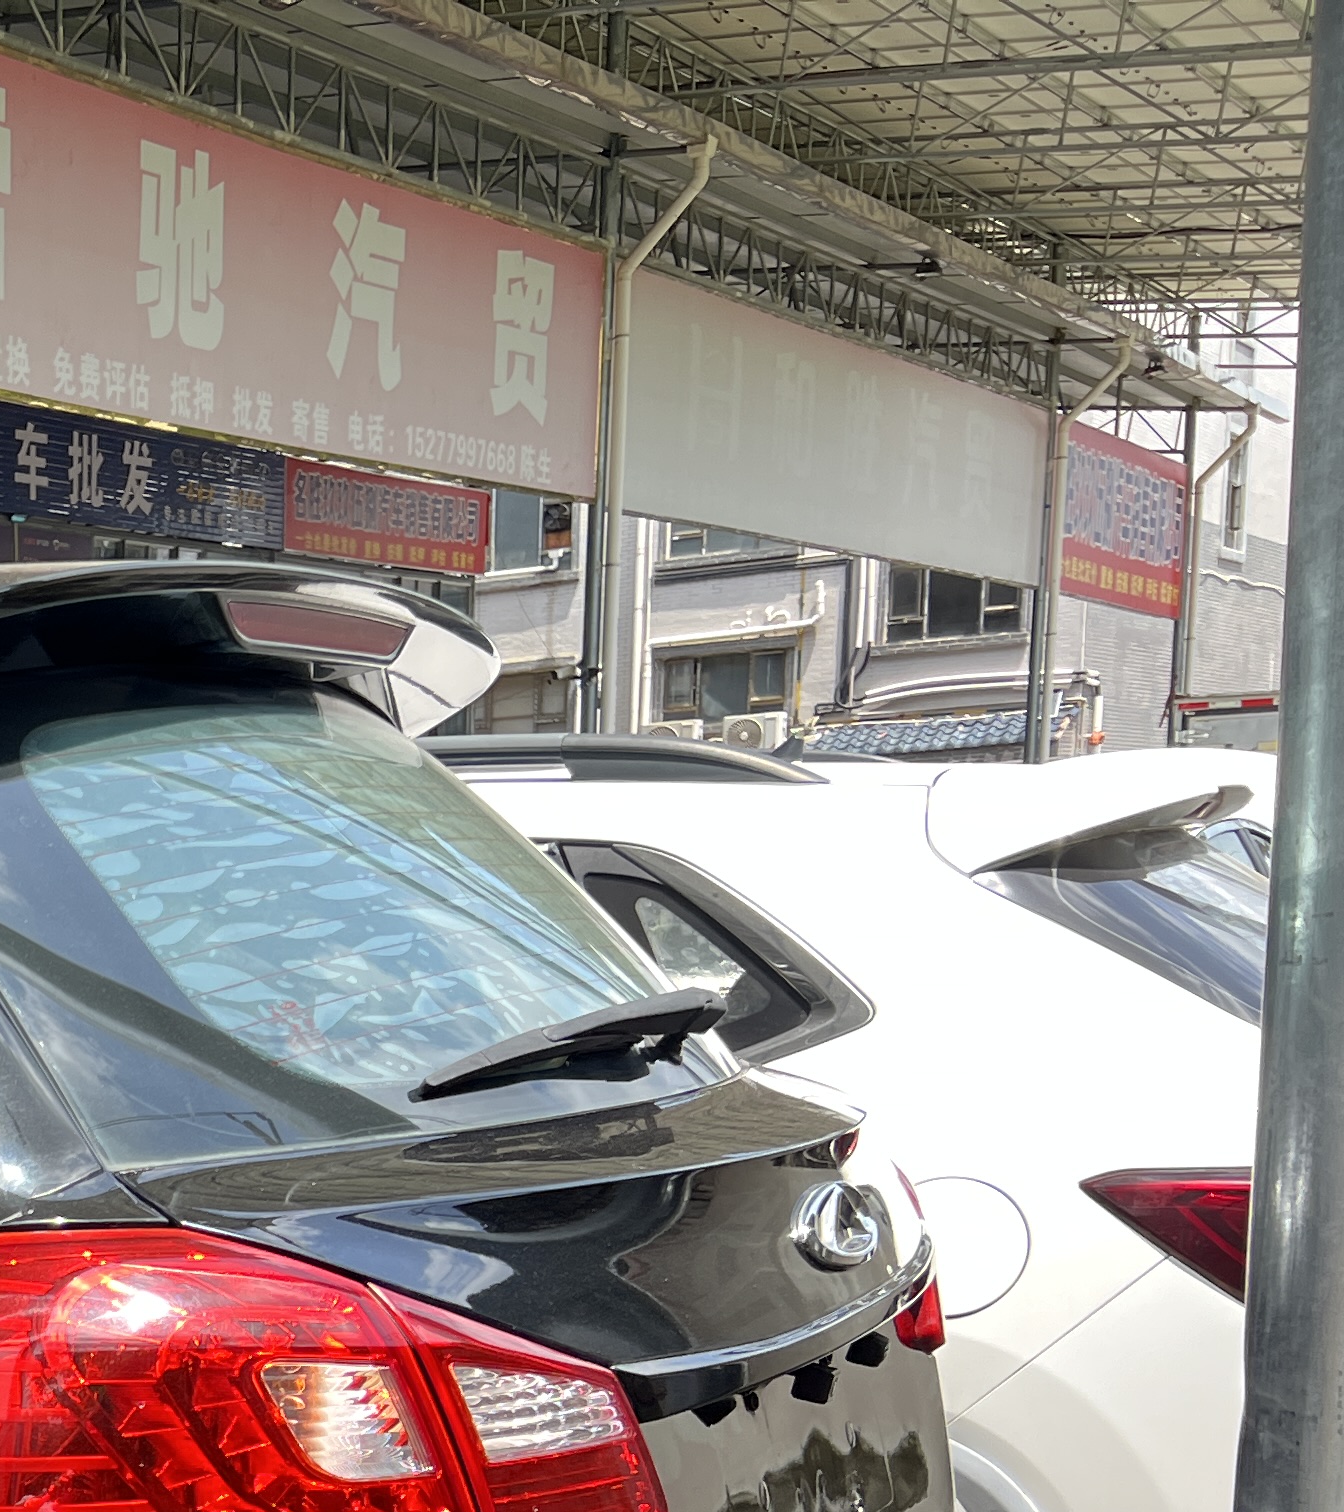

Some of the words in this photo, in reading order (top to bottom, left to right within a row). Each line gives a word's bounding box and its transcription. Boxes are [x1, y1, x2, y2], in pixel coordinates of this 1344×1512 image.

[53, 346, 151, 412] 免费评估
[170, 371, 214, 425] 抵押
[232, 385, 274, 437] 批发
[290, 397, 331, 446] 寄售
[405, 424, 517, 476] 15277997668
[518, 443, 553, 485] 陈生
